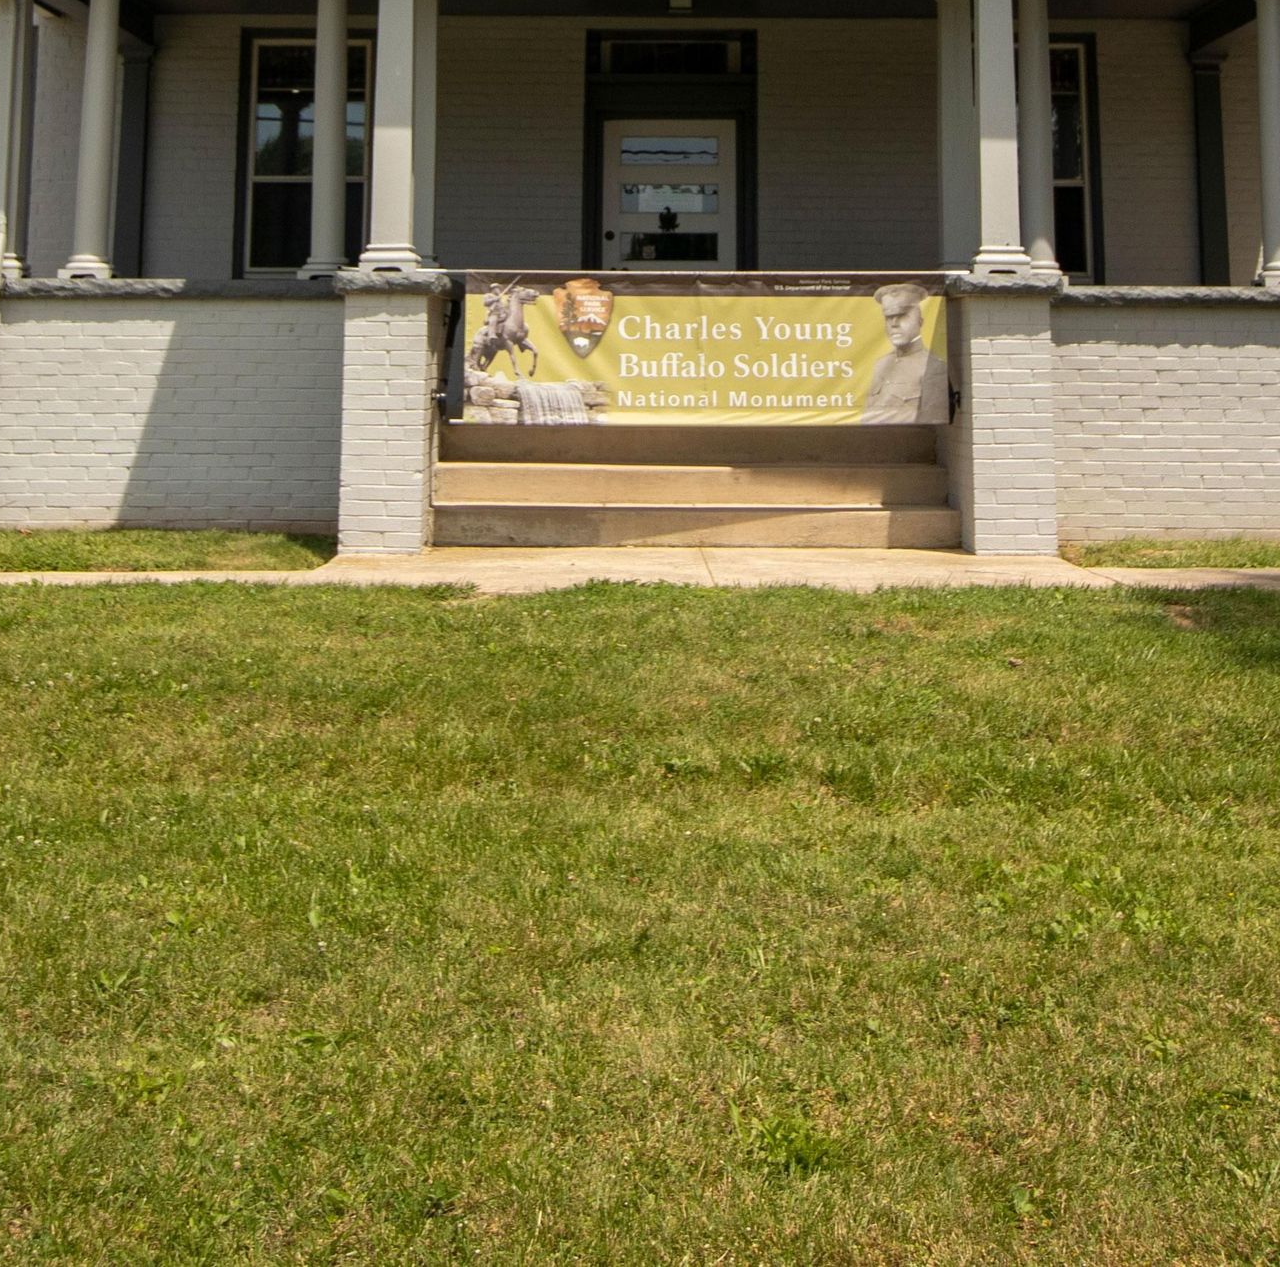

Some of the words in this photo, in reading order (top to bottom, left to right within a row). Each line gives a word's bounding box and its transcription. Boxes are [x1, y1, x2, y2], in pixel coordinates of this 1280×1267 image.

[618, 315, 742, 340] Charles
[754, 316, 853, 347] Young
[619, 352, 725, 378] Buffalo
[734, 353, 853, 378] Soldiers
[618, 390, 718, 407] National
[729, 391, 854, 407] Monument
